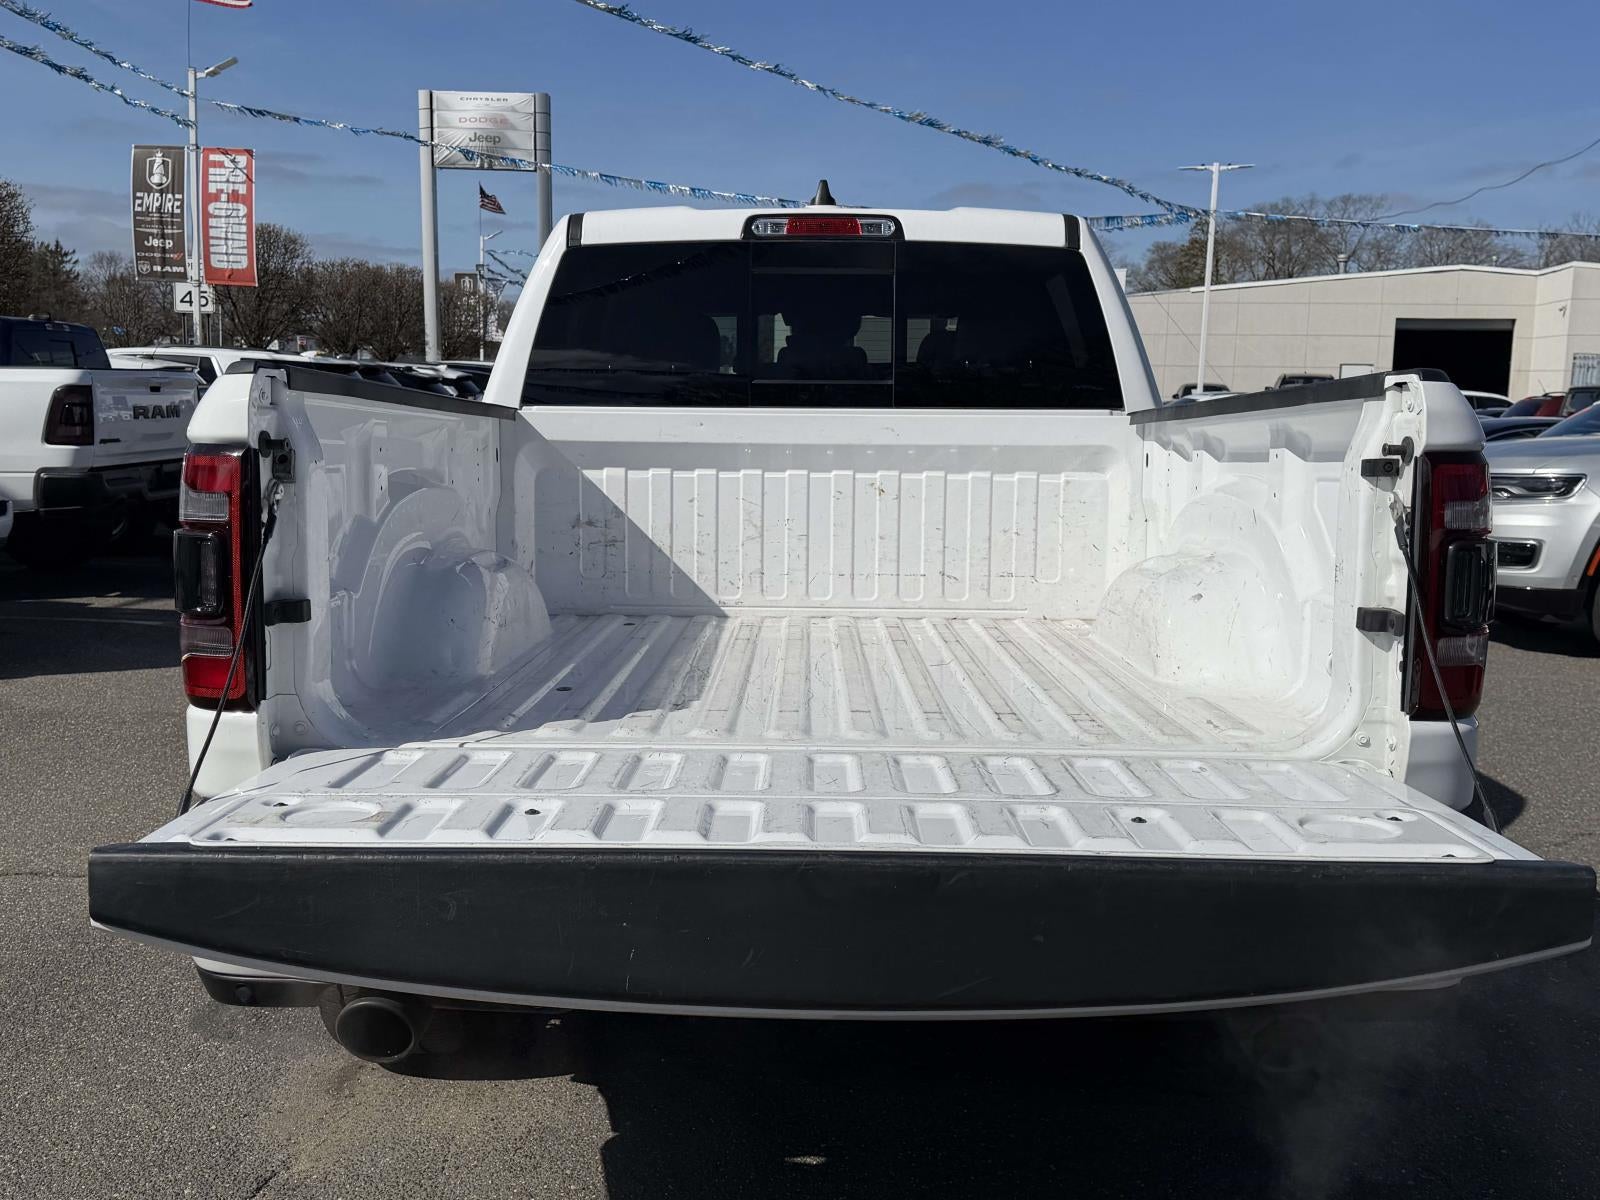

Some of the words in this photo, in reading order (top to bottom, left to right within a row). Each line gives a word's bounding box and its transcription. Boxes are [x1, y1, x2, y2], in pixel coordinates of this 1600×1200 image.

[469, 132, 501, 145] Jeep
[135, 192, 183, 213] EMPIRE
[144, 236, 173, 249] Jeep
[153, 265, 184, 273] RAM
[180, 291, 208, 307] 45
[133, 405, 181, 419] RAM
